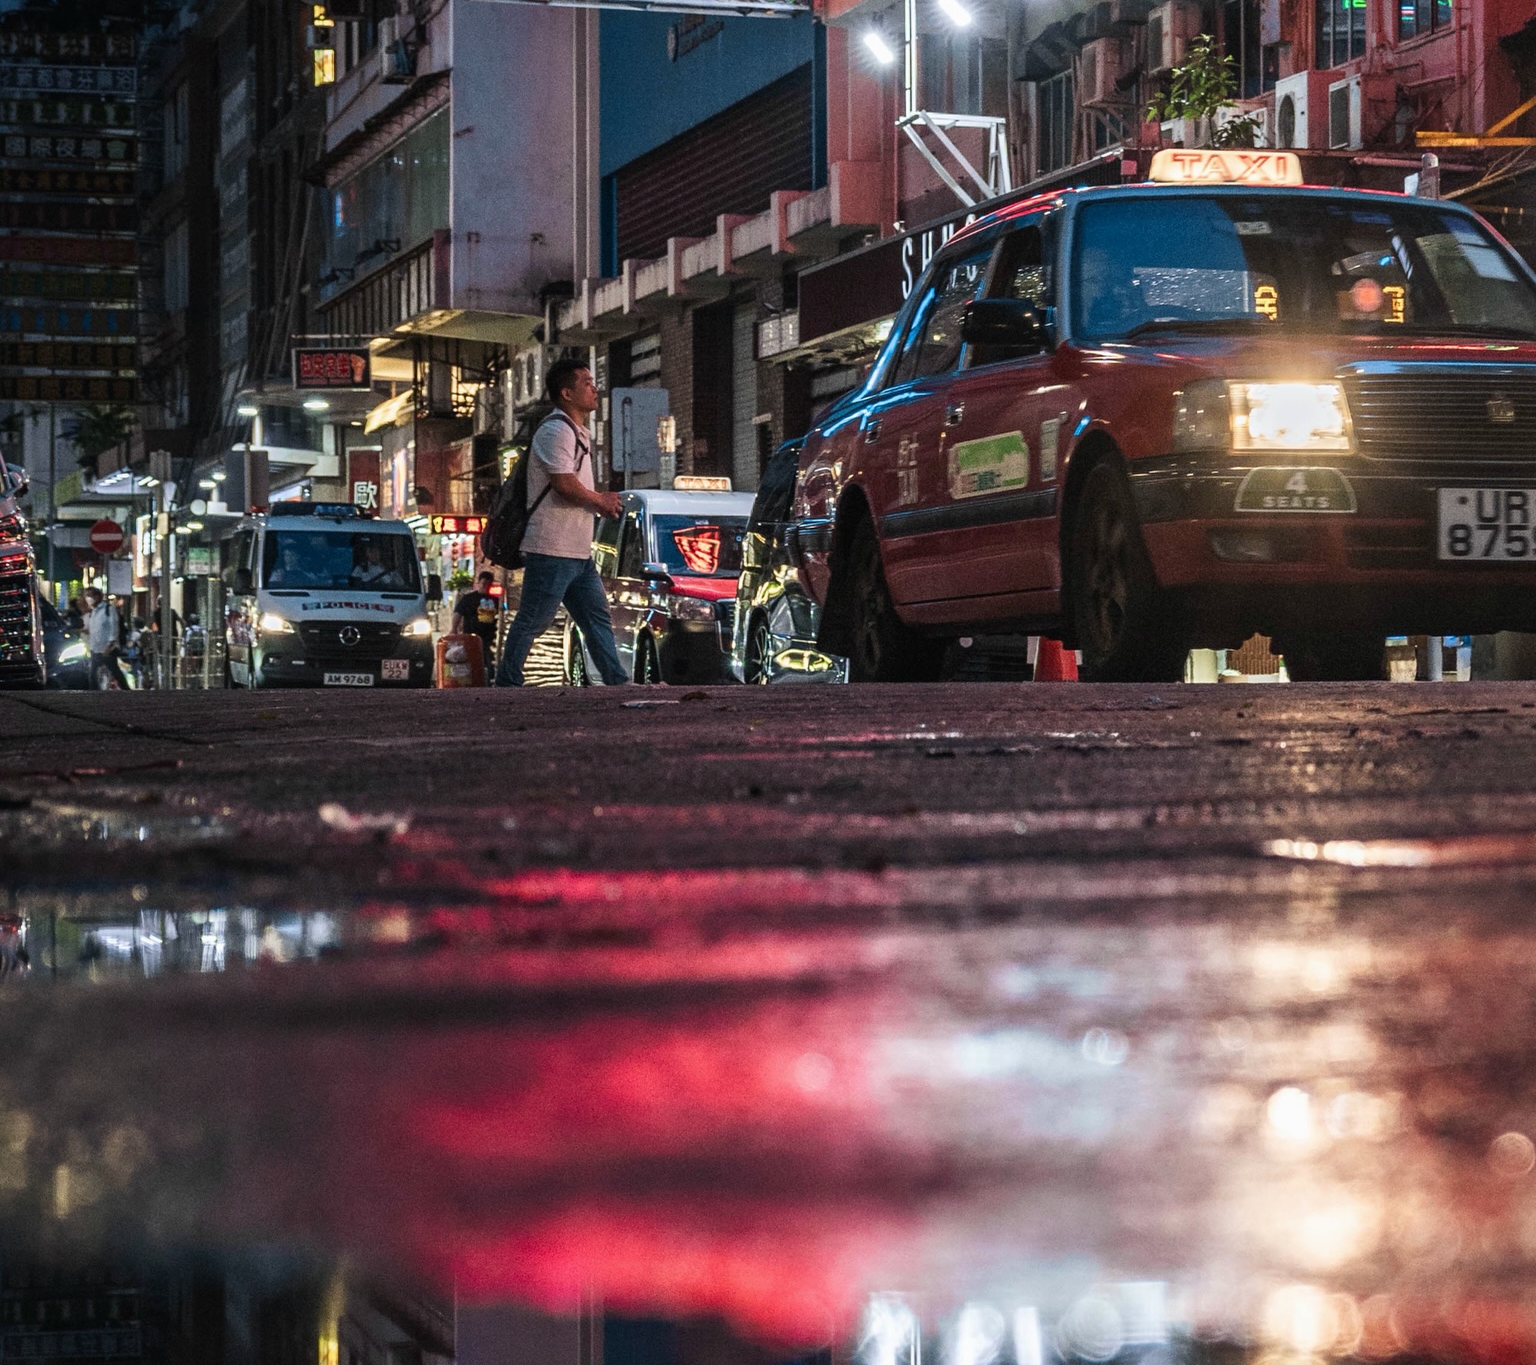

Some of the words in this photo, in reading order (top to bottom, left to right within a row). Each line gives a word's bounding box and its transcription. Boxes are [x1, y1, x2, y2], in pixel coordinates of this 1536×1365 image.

[1172, 154, 1290, 181] TAXI
[680, 477, 726, 489] TAXI
[1285, 471, 1308, 495] 4
[354, 480, 378, 509] 歐
[1262, 496, 1330, 509] SEATS
[1476, 489, 1532, 525] UR
[343, 676, 370, 685] 9768
[388, 670, 402, 679] 22
